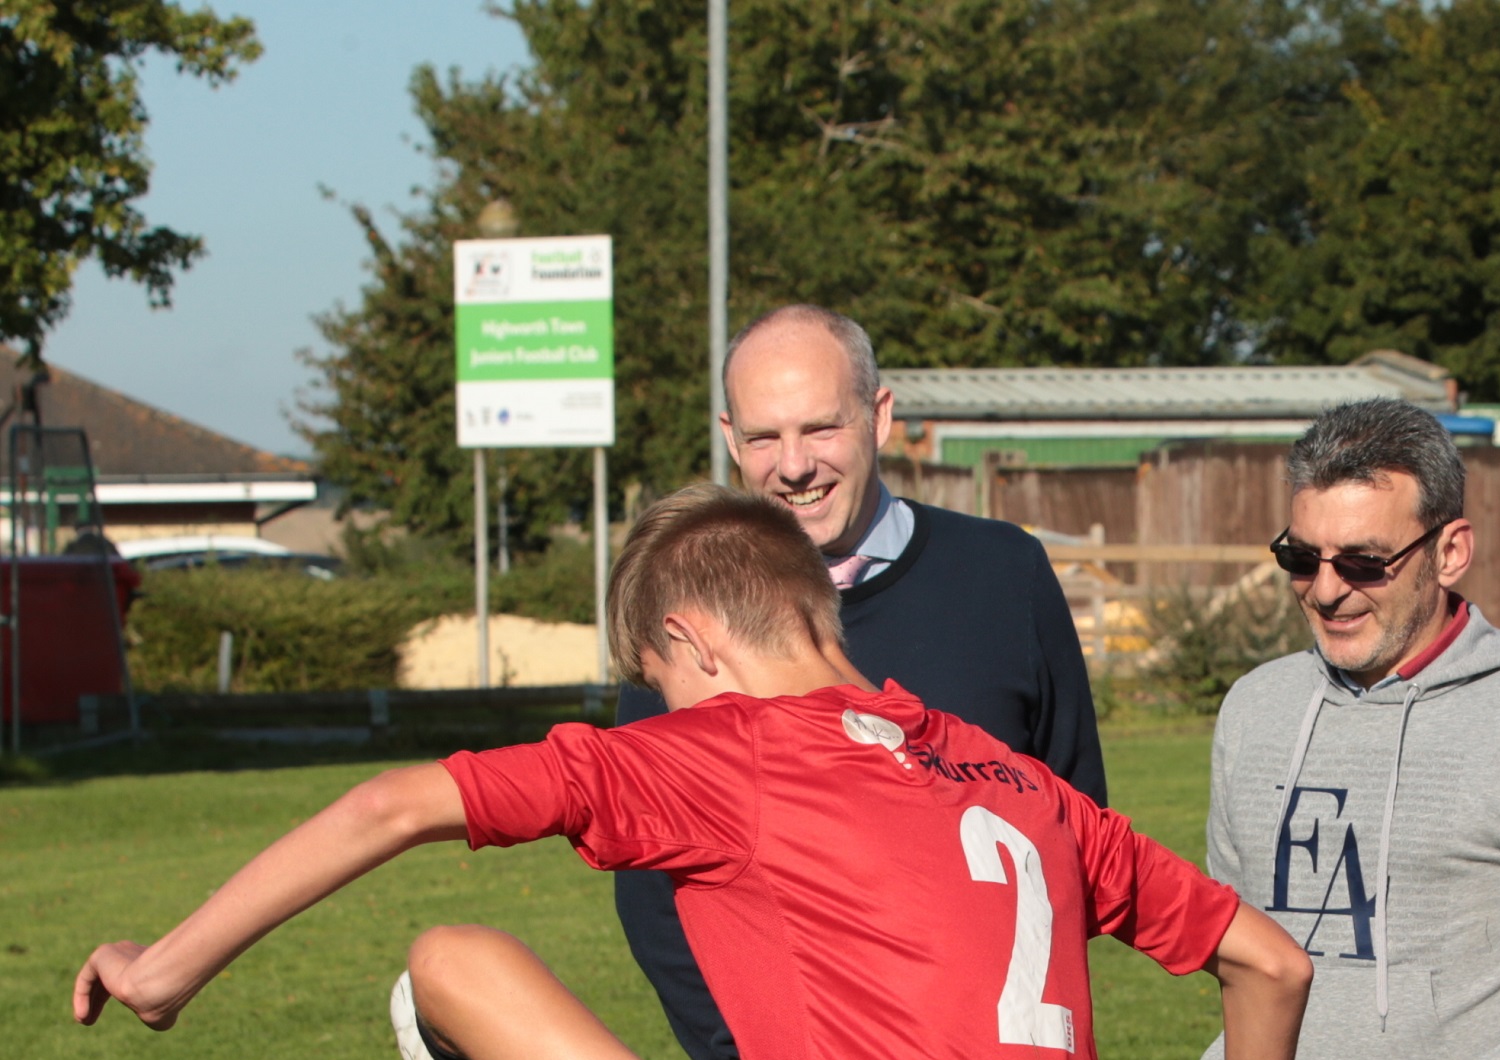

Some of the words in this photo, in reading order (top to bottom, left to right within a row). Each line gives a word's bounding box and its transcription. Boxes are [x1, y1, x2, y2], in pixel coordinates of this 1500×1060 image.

[550, 317, 587, 334] Town
[567, 344, 599, 363] Club
[959, 805, 1075, 1054] 2
